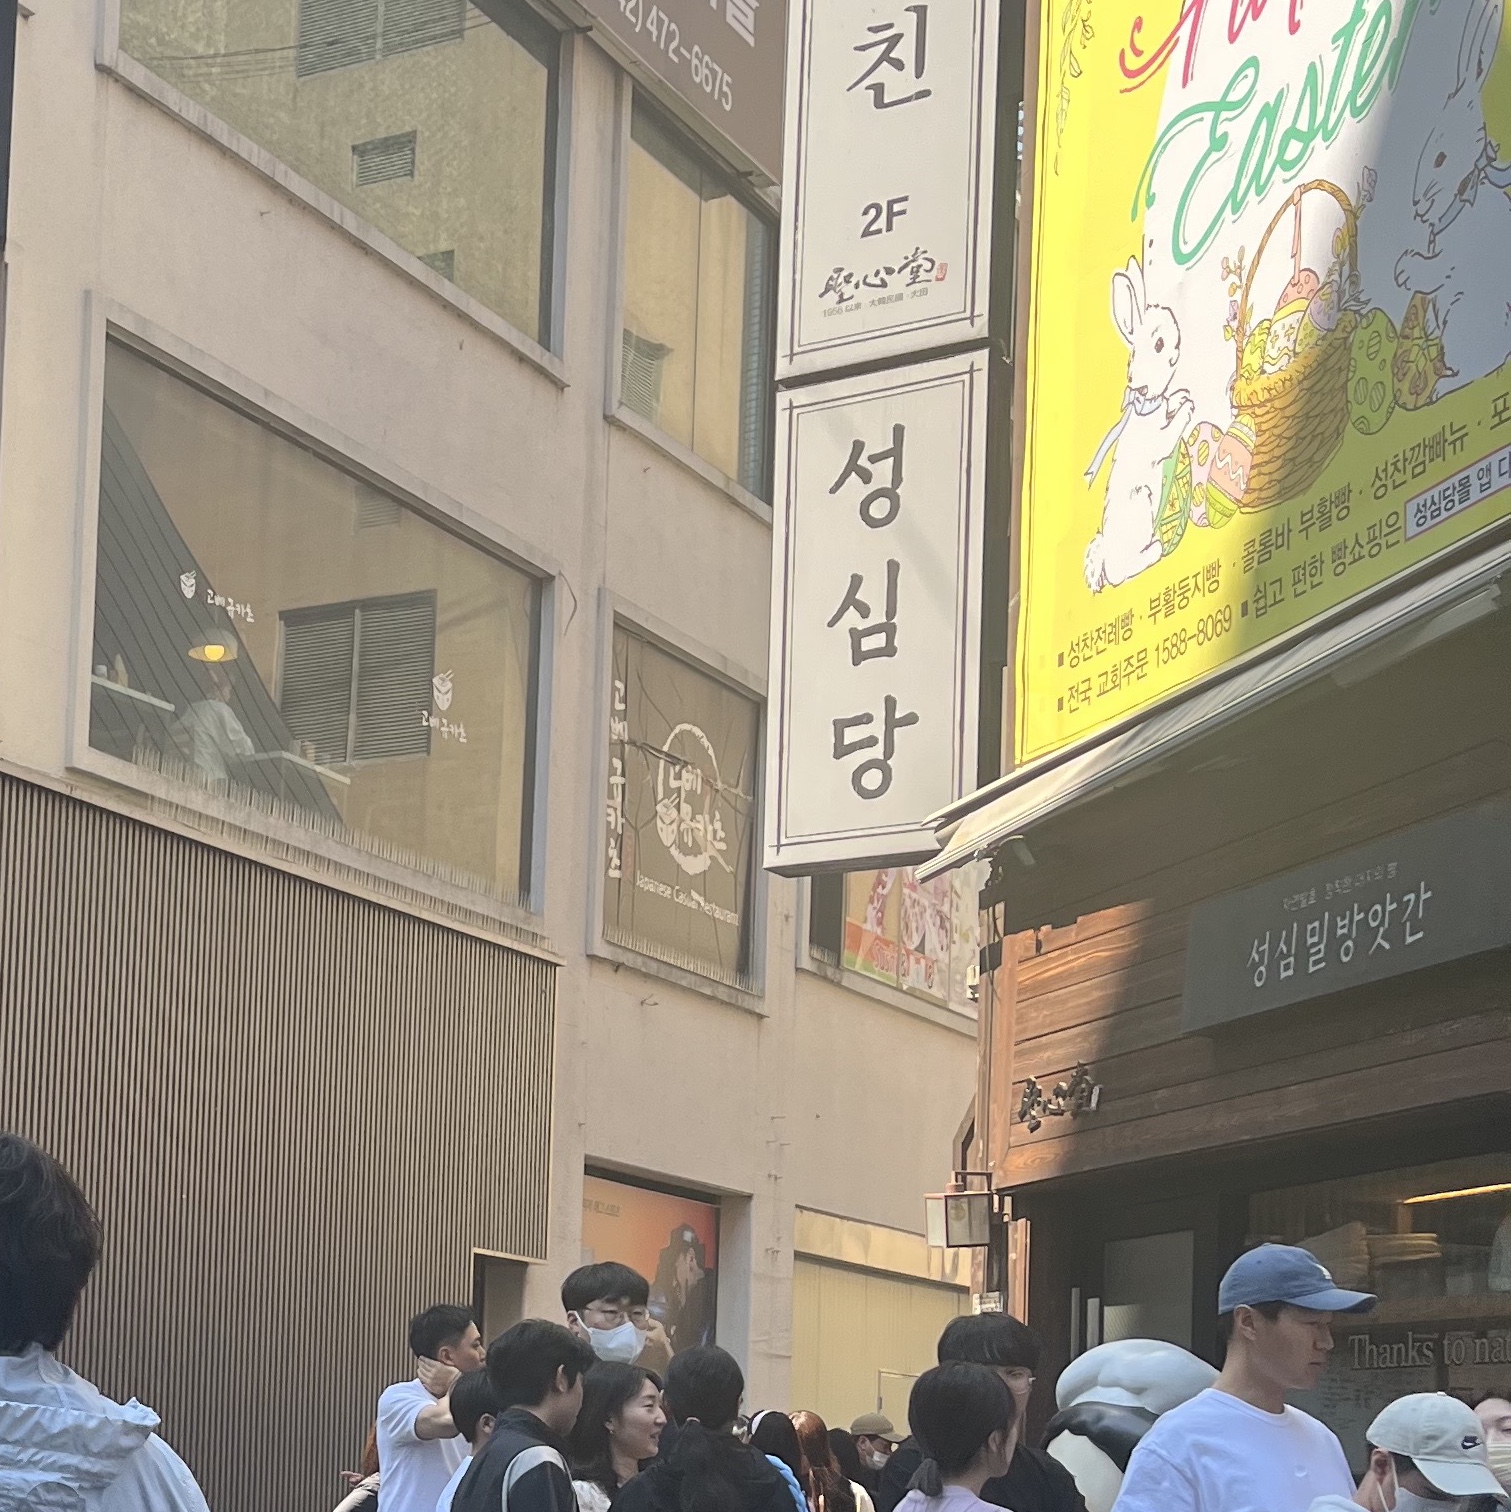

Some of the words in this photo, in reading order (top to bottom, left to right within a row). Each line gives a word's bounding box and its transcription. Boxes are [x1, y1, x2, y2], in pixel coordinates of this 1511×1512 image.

[645, 4, 733, 112] 472-6675
[845, 4, 932, 110] 친
[859, 194, 910, 239] 2F
[1066, 607, 1135, 669] 성찬전례빵
[1147, 557, 1222, 626] 부활둥지빵
[1240, 517, 1292, 575] 콜롬바
[1298, 481, 1353, 541] 부활빵
[1370, 421, 1469, 501] 성찬깜빠뉴
[1067, 676, 1093, 714] 전국
[1096, 646, 1149, 698] 교회주문
[1154, 604, 1232, 669] 1588-8069
[1252, 576, 1285, 620] 쉽고
[1290, 551, 1325, 599] 편한
[1413, 474, 1472, 528] 성심당몰
[1476, 461, 1492, 494] 앱
[826, 422, 920, 801] 성심당
[1246, 880, 1433, 988] 성심밀방앗간
[1347, 1331, 1434, 1370] Thanks
[1442, 1332, 1466, 1366] to
